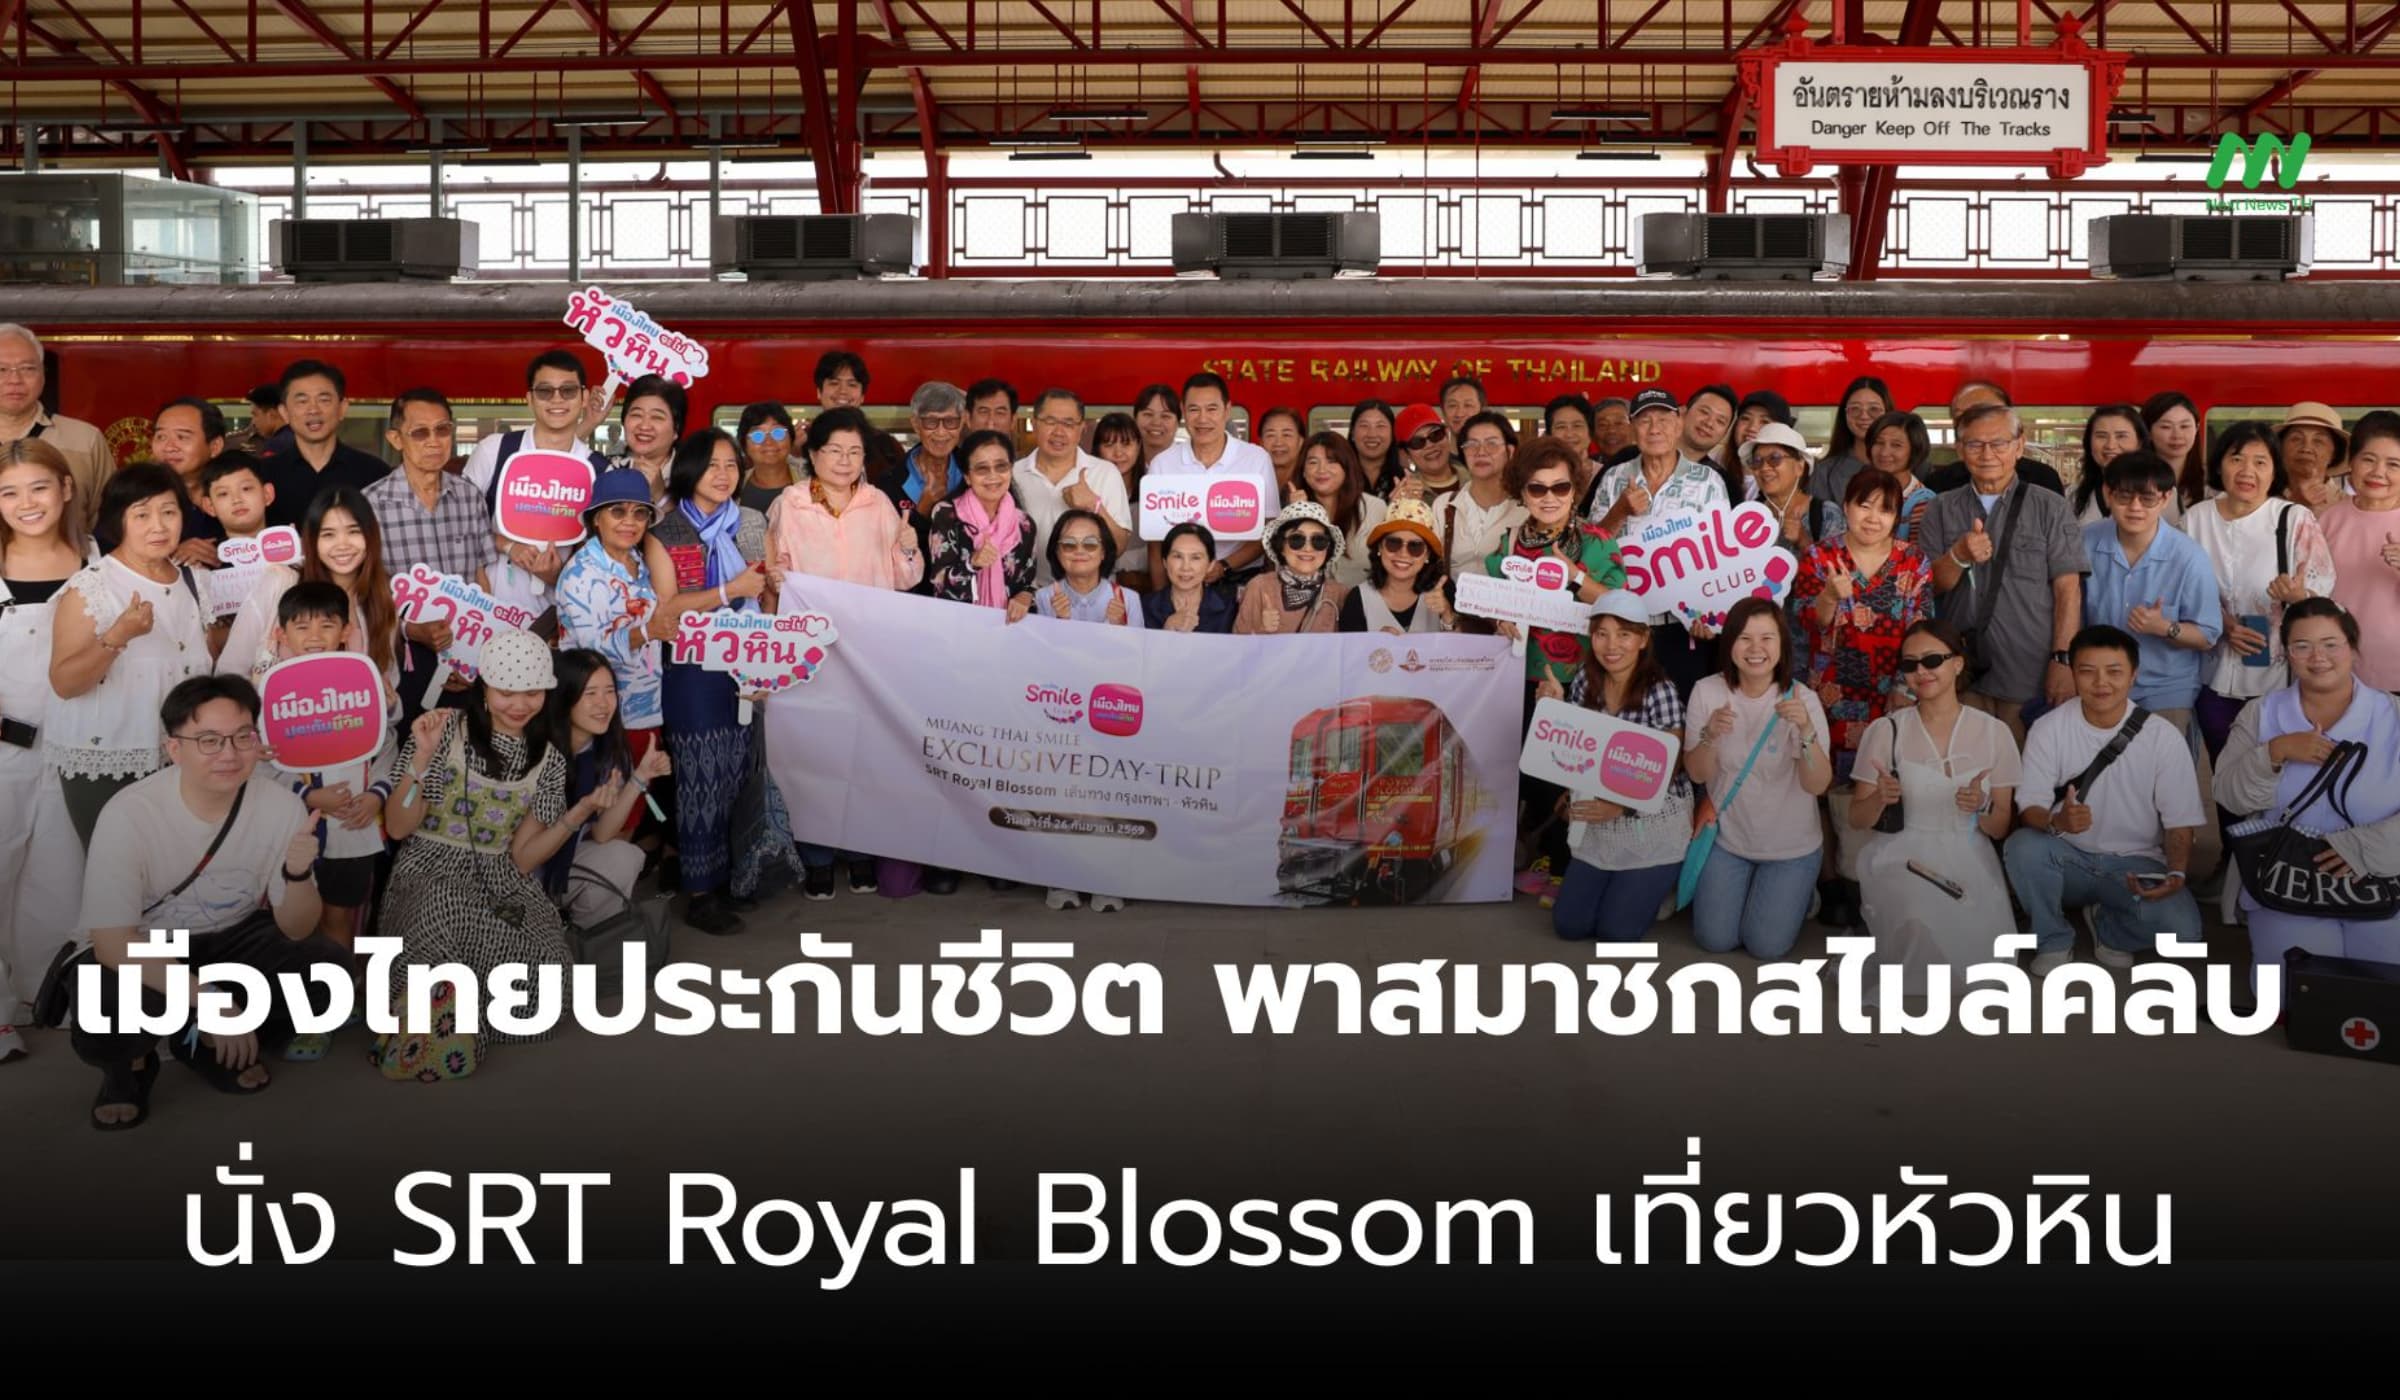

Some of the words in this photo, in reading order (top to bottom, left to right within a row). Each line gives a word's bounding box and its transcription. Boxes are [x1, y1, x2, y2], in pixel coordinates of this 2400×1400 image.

[1793, 75, 2070, 109] อันตรายห้ามลงบริเวณราง
[1812, 121, 1866, 138] Danger
[1876, 121, 1914, 138] Keep
[1924, 121, 1950, 135] Off
[1961, 121, 1990, 135] The
[2000, 121, 2051, 136] Tracks
[567, 290, 670, 376] หัวหิน
[611, 304, 660, 338] เมืองไทย
[1203, 360, 1294, 382] STATE
[1311, 360, 1437, 382] RAILWAY
[1453, 360, 1492, 382] OF
[1507, 360, 1660, 382] THAILAND
[508, 476, 586, 502] เมืองไทย
[1145, 492, 1199, 510] Smile
[1210, 495, 1256, 508] เมืองไทย
[1642, 516, 1693, 543] เมืองไทย
[1622, 509, 1771, 596] Smile
[439, 580, 494, 612] เมืองไทย
[1702, 568, 1756, 597] CLUB
[714, 614, 772, 629] เมืองไทย
[675, 615, 796, 664] หัวหิน
[272, 688, 371, 721] เมืองไทย
[1025, 684, 1082, 705] Smile
[1093, 696, 1139, 713] เมืองไทย
[926, 717, 984, 736] MUANG
[992, 727, 1029, 742] THAI
[1035, 734, 1080, 746] SMILE
[1535, 720, 1597, 752] Smile
[1607, 746, 1662, 773] เมืองไทย
[925, 764, 948, 780] SRT
[952, 773, 991, 790] Royal
[995, 780, 1057, 796] Blossom
[1181, 796, 1218, 811] หัวหิน
[1054, 819, 1067, 829] 26
